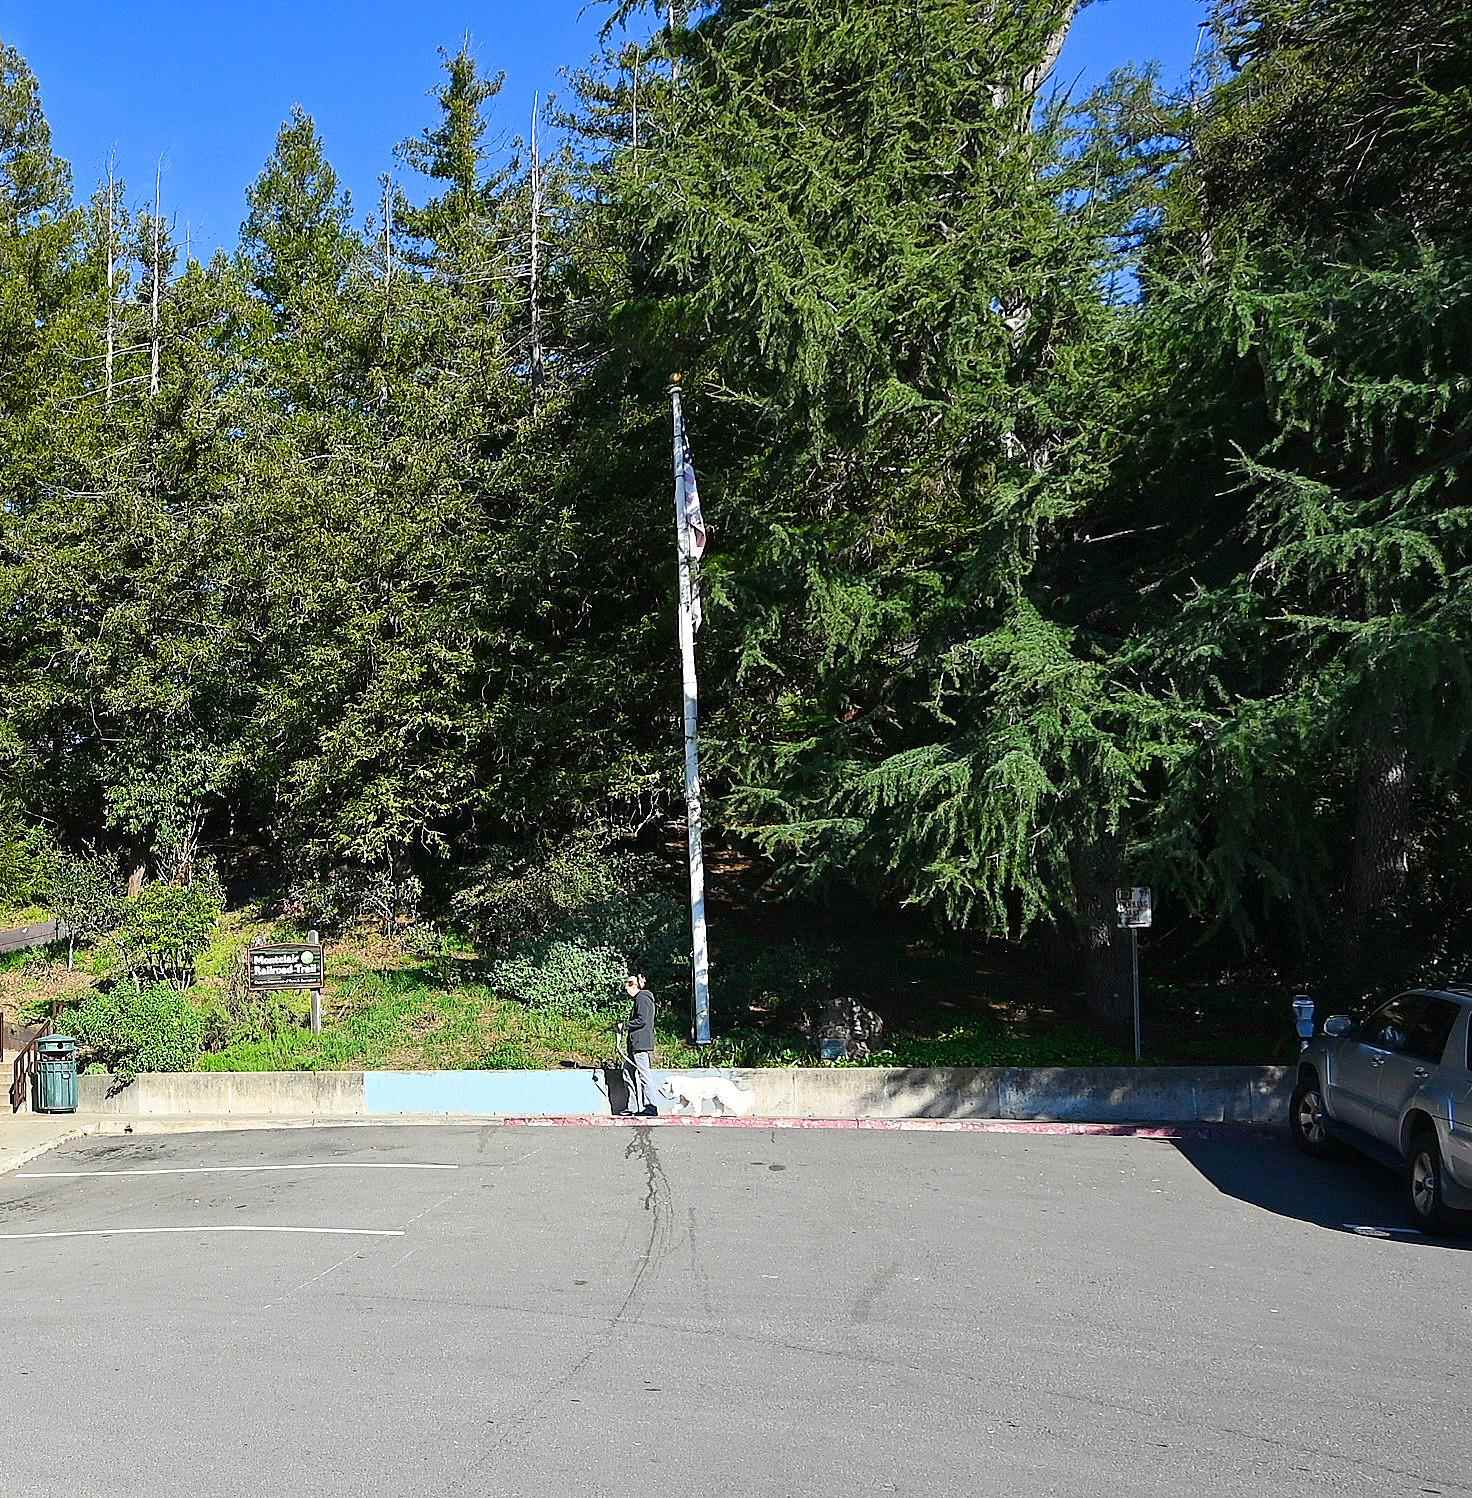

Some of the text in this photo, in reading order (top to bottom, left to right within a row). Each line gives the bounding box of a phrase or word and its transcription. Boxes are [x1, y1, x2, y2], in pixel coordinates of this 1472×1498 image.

[254, 954, 299, 964] Montclair
[254, 963, 317, 975] Railroad Trail
